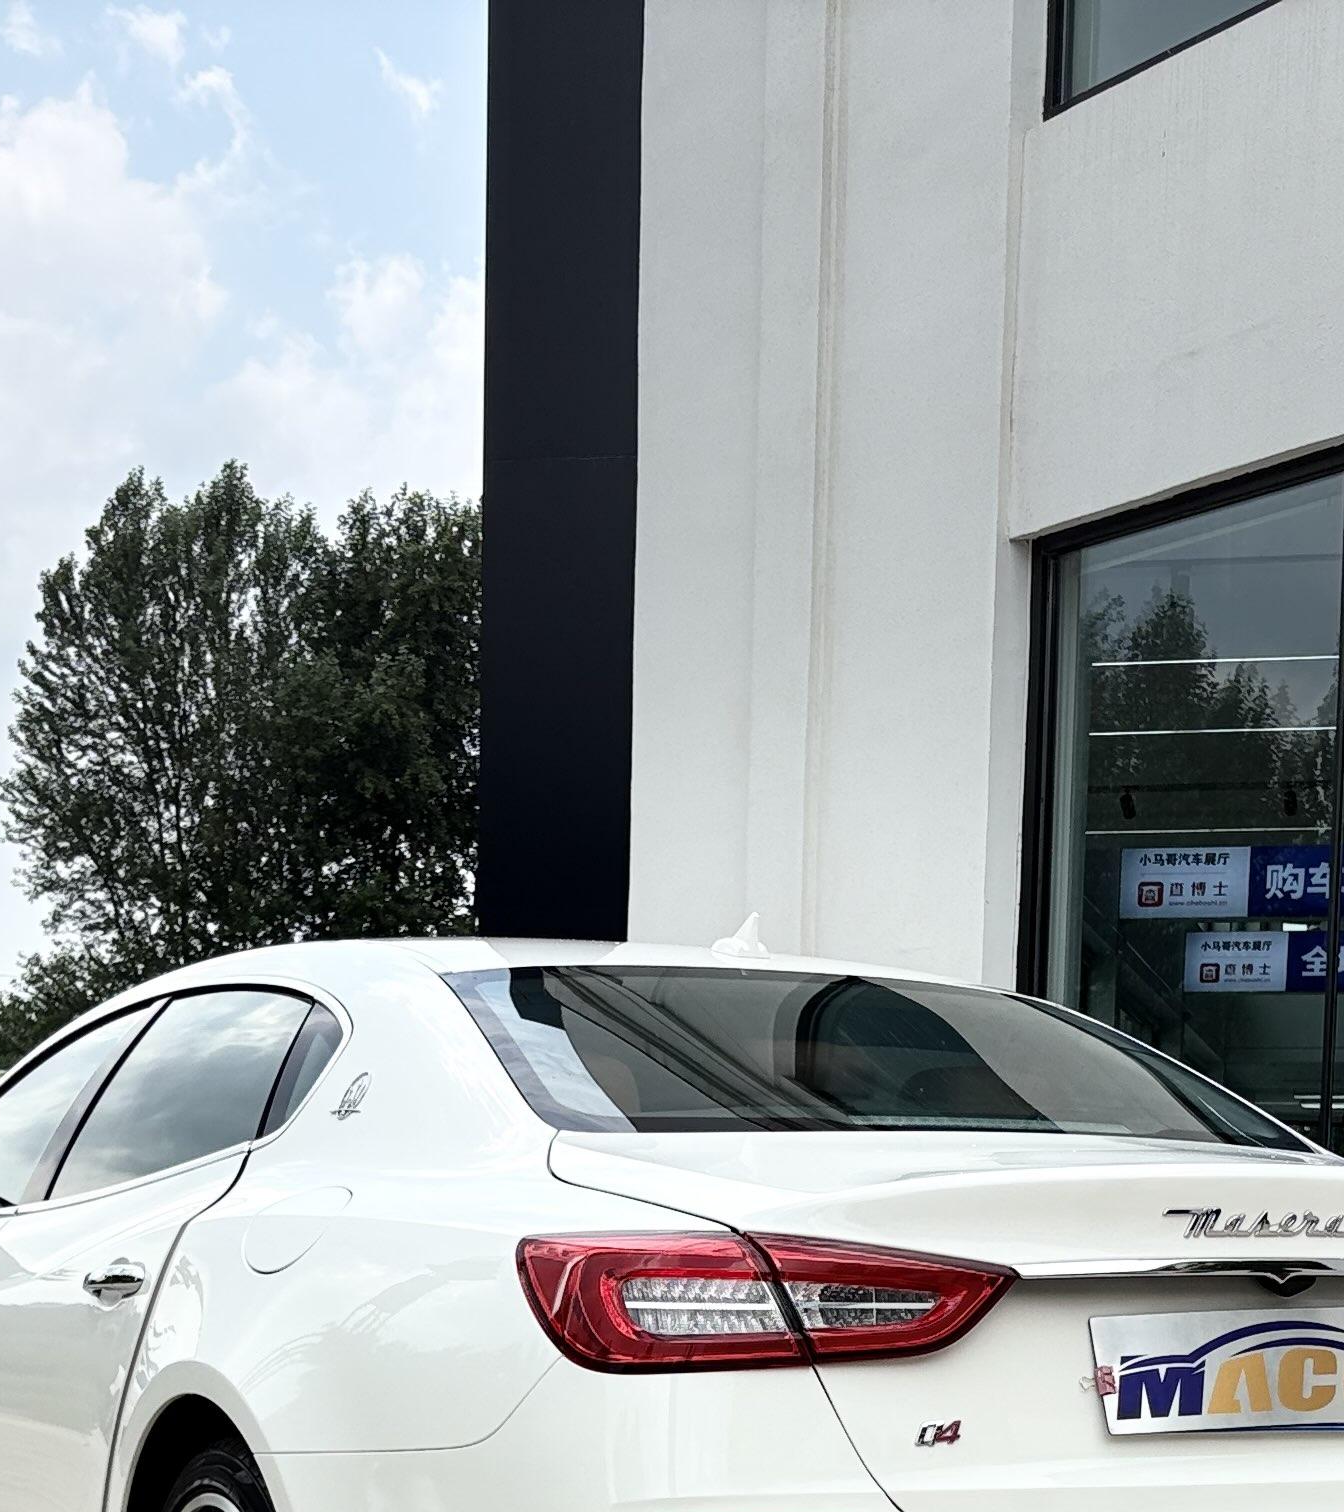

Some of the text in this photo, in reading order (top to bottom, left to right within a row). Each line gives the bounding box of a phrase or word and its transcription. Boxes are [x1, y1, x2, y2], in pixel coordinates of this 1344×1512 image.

[1139, 853, 1230, 866] 小马哥汽车展厅
[1200, 940, 1273, 952] 小马哥汽车展厅
[916, 1419, 962, 1447] Q4
